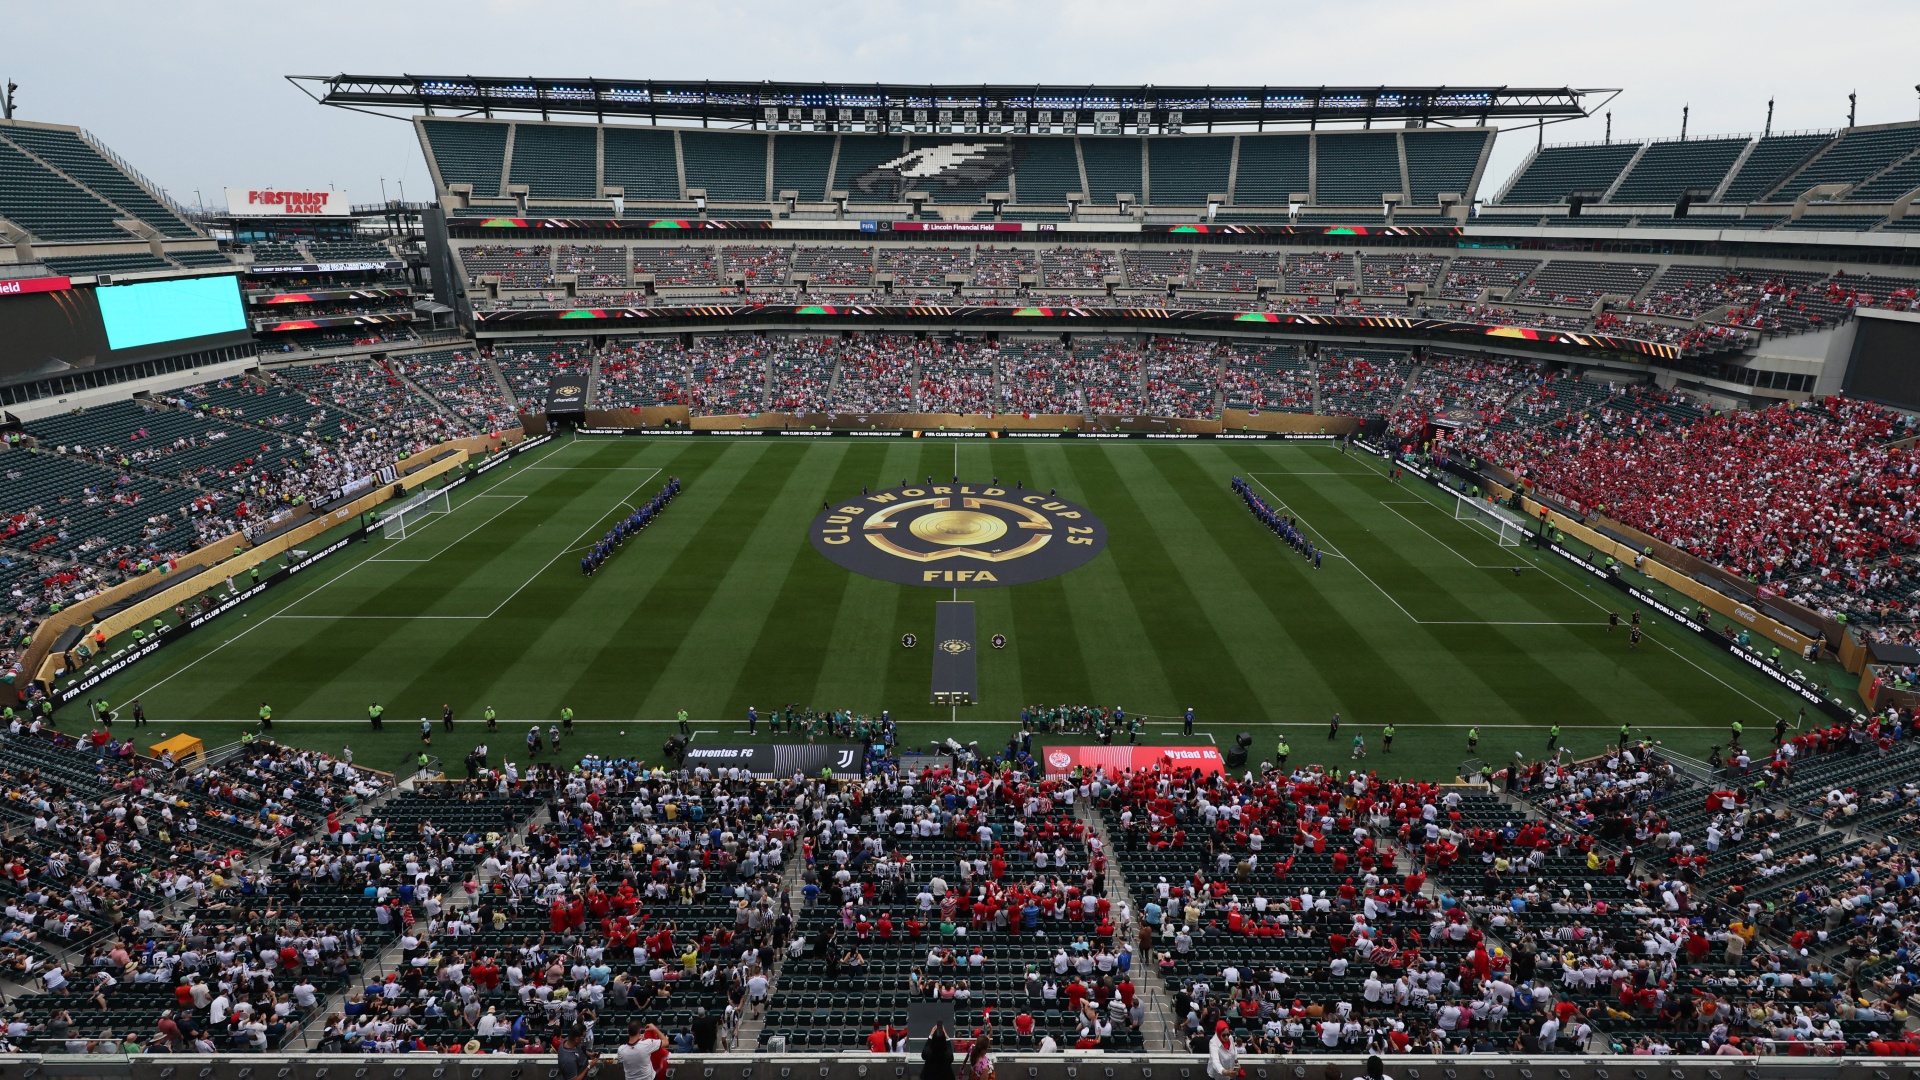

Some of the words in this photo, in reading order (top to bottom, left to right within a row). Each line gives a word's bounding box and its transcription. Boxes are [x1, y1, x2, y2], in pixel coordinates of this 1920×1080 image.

[286, 204, 322, 213] BANK
[336, 508, 349, 518] VISA
[823, 506, 864, 545] CLUB
[866, 486, 1006, 504] WORLD
[1022, 495, 1082, 520] CUP
[1066, 525, 1093, 546] 25
[290, 565, 300, 574] FIFA
[300, 558, 312, 568] CLUB
[312, 550, 328, 561] WORLD
[1550, 544, 1560, 553] FIFA
[1560, 549, 1570, 558] CLUB
[1570, 555, 1585, 567] WORLD
[1586, 564, 1595, 572] CUP
[923, 571, 998, 582] FIFA
[190, 618, 204, 628] FIFA
[204, 609, 220, 620] CLUB
[220, 597, 241, 612] WORLD
[240, 591, 252, 600] CUP
[1629, 588, 1640, 599] FIFA
[1640, 594, 1654, 606] CLUB
[1654, 602, 1674, 617] WORLD
[1674, 613, 1686, 623] CUP
[1774, 628, 1798, 644] Hisense
[1730, 645, 1744, 658] FIFA
[1744, 654, 1761, 668] CLUB
[1761, 663, 1786, 683] WORLD
[1786, 680, 1801, 691] CUP
[62, 687, 80, 702] FIFA
[80, 675, 100, 691] CLUB
[100, 660, 126, 679] WORLD
[126, 652, 141, 663] CUP
[688, 749, 738, 758] Juventus
[740, 749, 753, 758] FC
[1164, 750, 1201, 760] Wydad
[142, 956, 147, 964] 8
[155, 957, 162, 965] 13
[1344, 1008, 1348, 1017] 7
